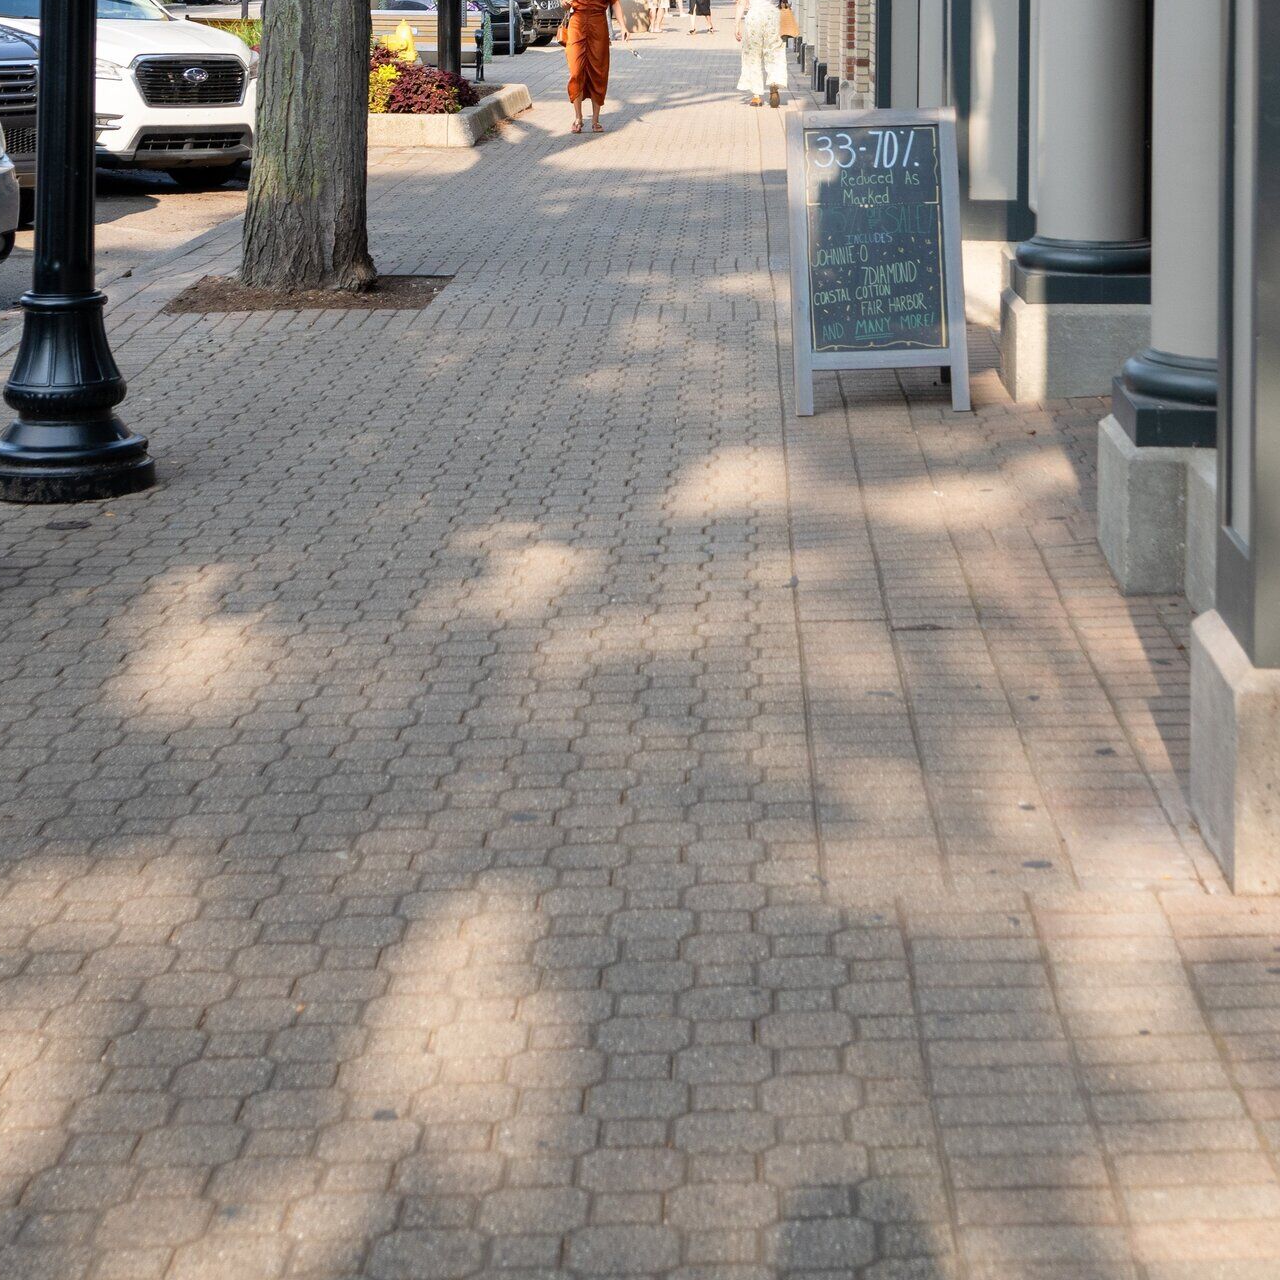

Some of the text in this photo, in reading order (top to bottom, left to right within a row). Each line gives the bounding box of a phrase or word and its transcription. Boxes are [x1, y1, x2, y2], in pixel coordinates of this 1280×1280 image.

[814, 130, 920, 169] 33-70%
[840, 169, 894, 187] Reduced
[813, 284, 891, 306] COASTAL COTTON
[861, 292, 928, 316] FAIR HARBOR
[822, 322, 844, 341] AND
[855, 317, 892, 334] MANY
